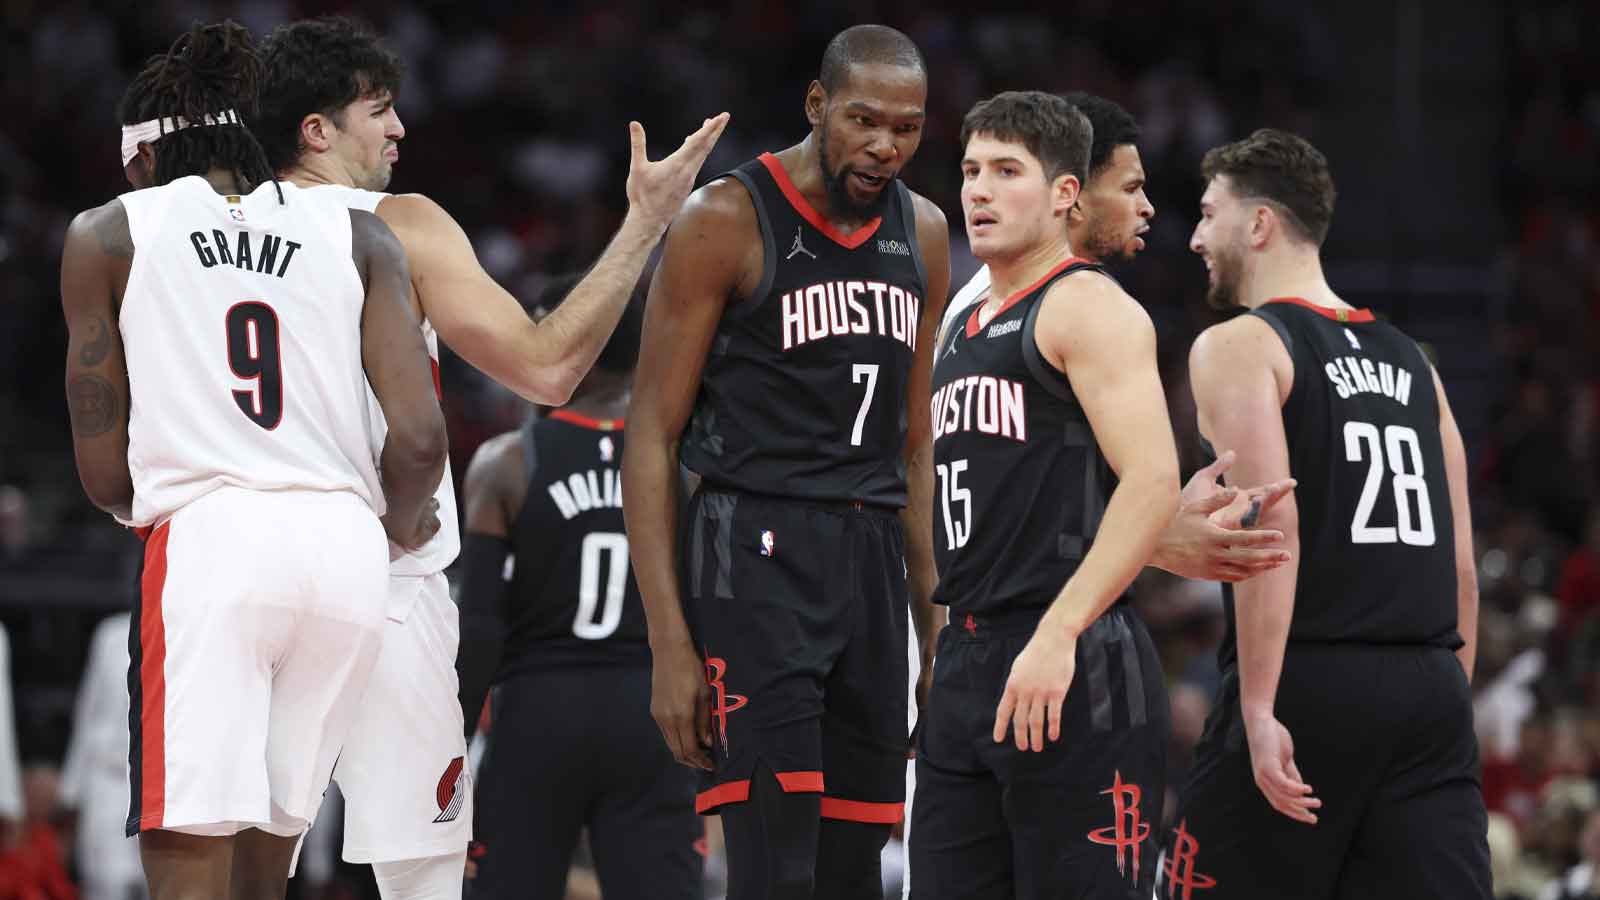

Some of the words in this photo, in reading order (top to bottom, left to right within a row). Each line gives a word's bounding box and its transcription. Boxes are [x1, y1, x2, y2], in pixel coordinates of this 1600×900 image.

[189, 228, 302, 278] GRANT
[781, 279, 919, 352] HOUSTON
[225, 299, 284, 432] 9
[851, 363, 880, 446] 7
[1324, 356, 1412, 406] SENGUN
[931, 375, 1026, 442] OUSTON
[936, 458, 972, 551] 15
[1343, 421, 1436, 546] 28
[572, 532, 630, 640] 0
